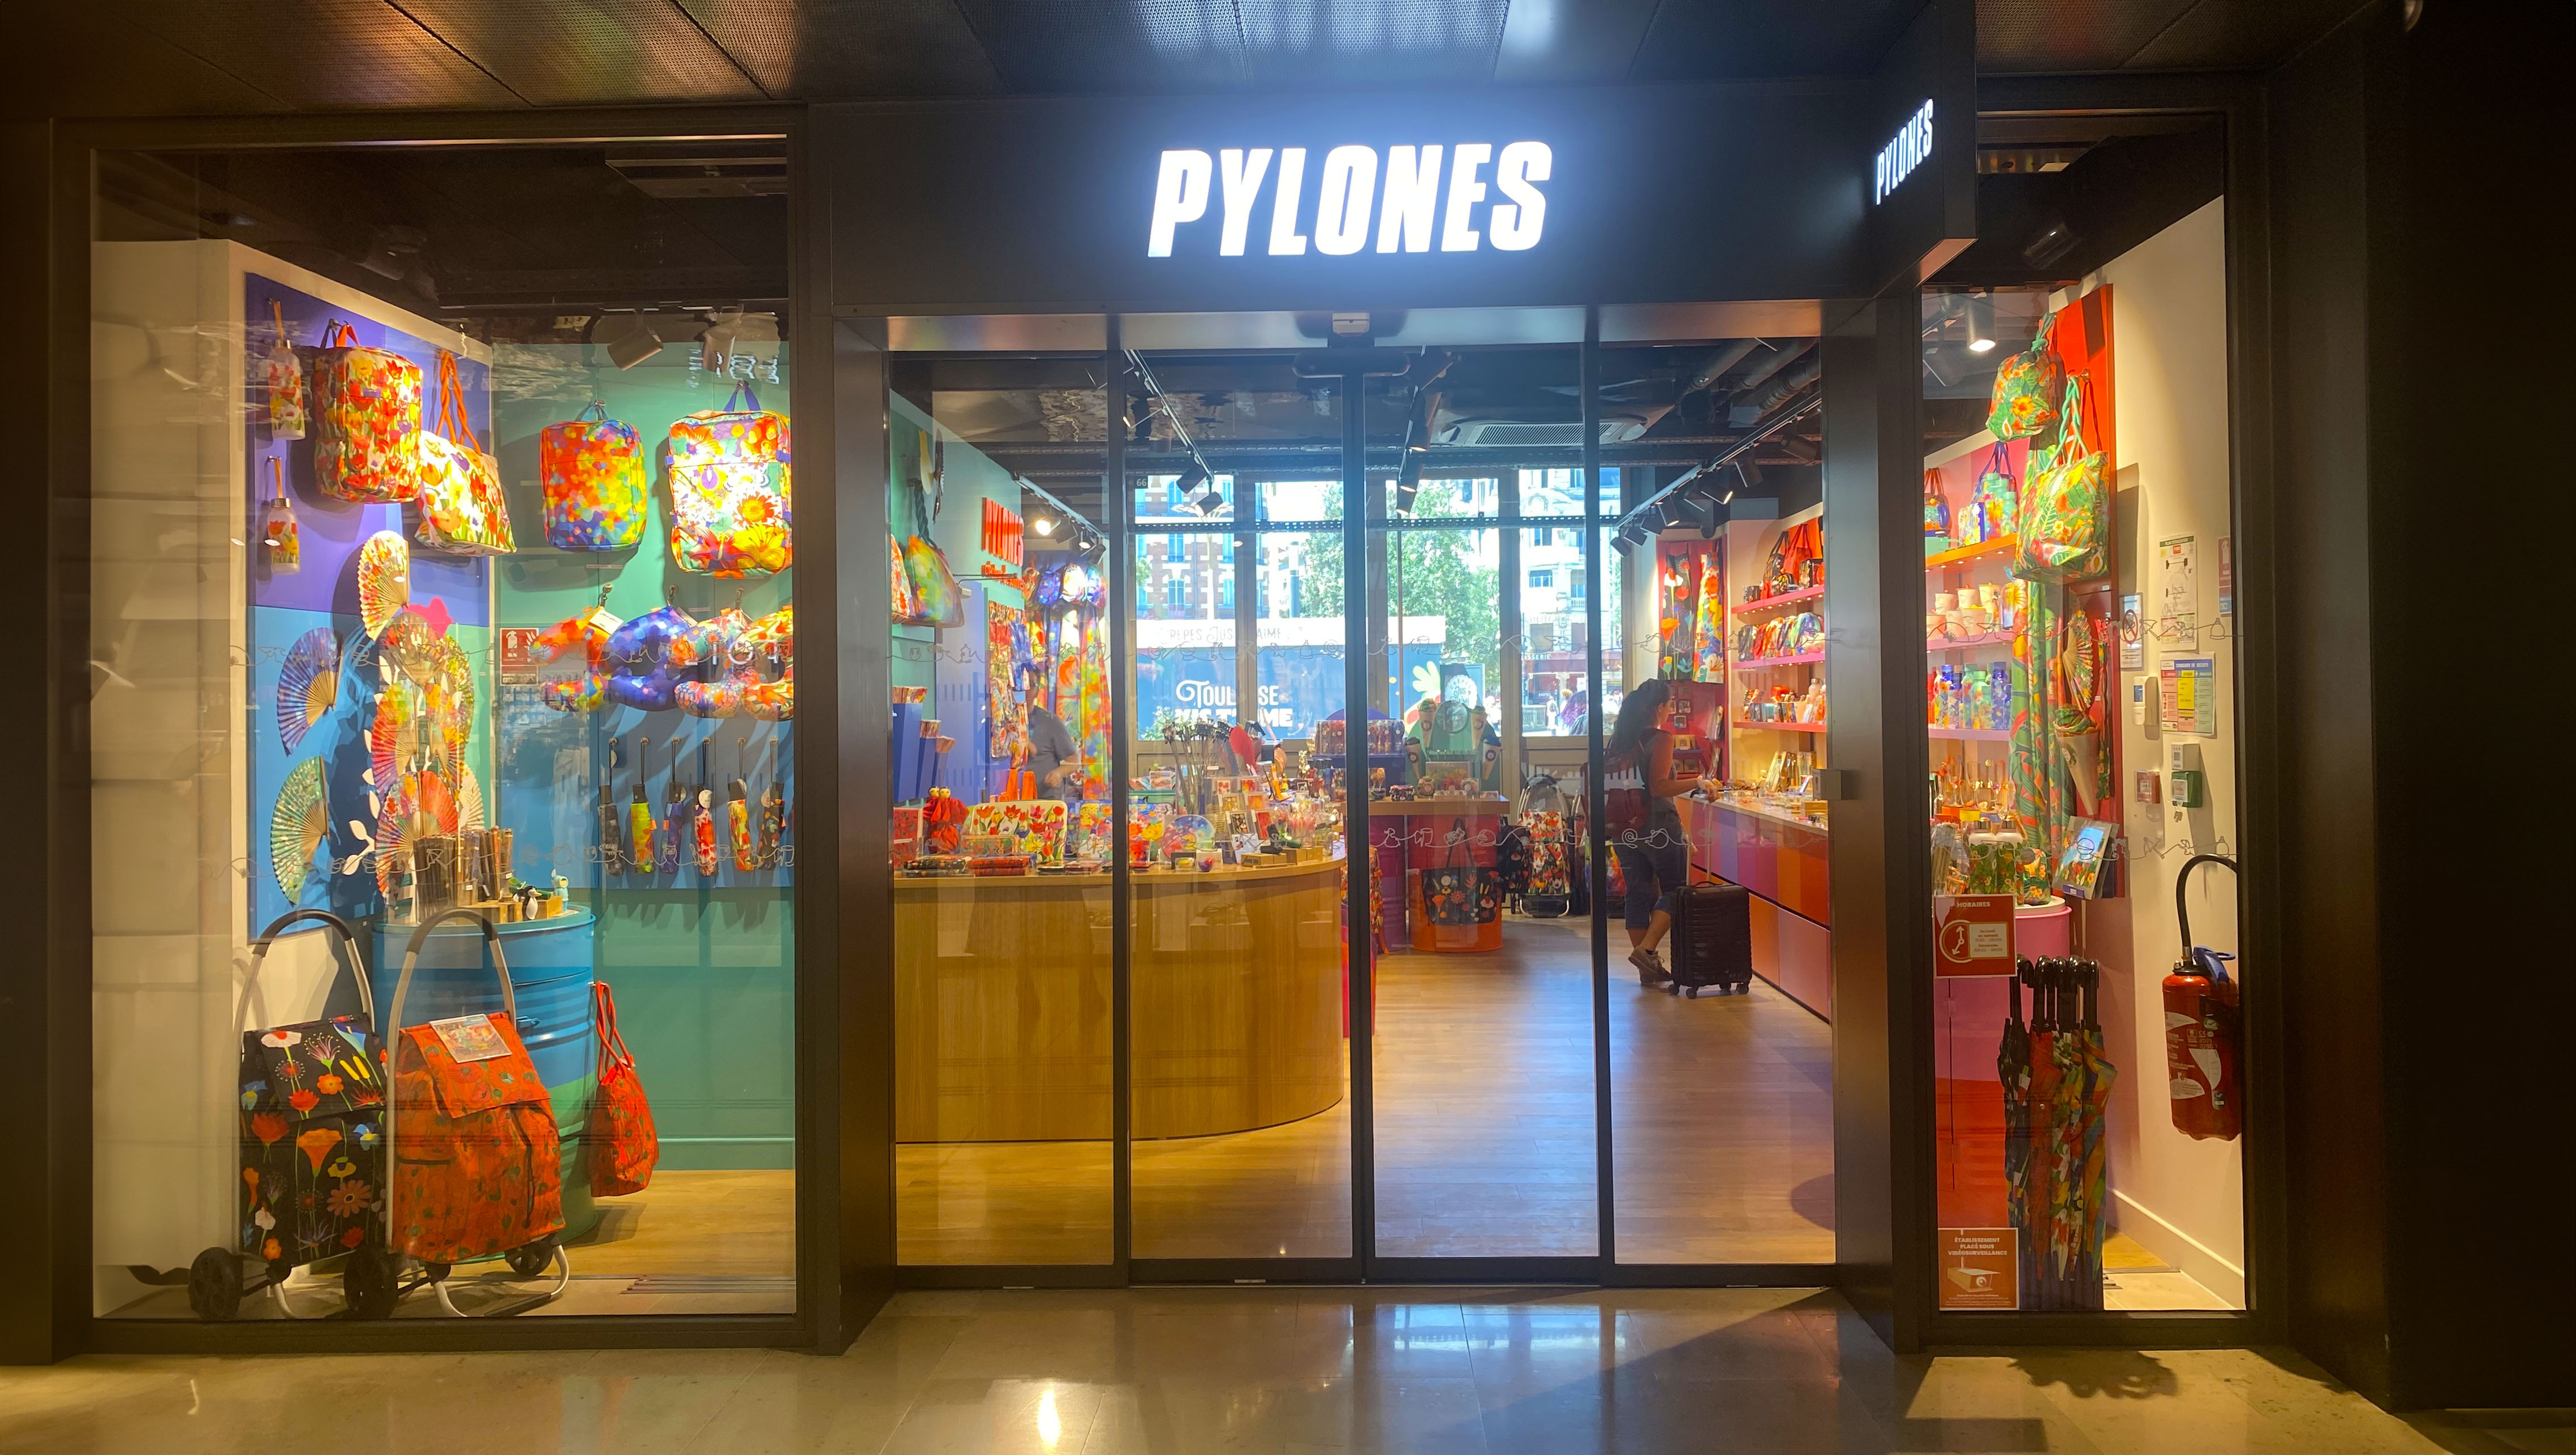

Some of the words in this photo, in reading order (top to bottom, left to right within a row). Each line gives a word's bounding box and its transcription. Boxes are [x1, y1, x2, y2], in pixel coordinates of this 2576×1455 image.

[1876, 98, 1933, 205] PYLONES
[1147, 141, 1552, 257] PYLONES
[982, 497, 1024, 566] PYLONES
[1176, 679, 1279, 708] TOULSE
